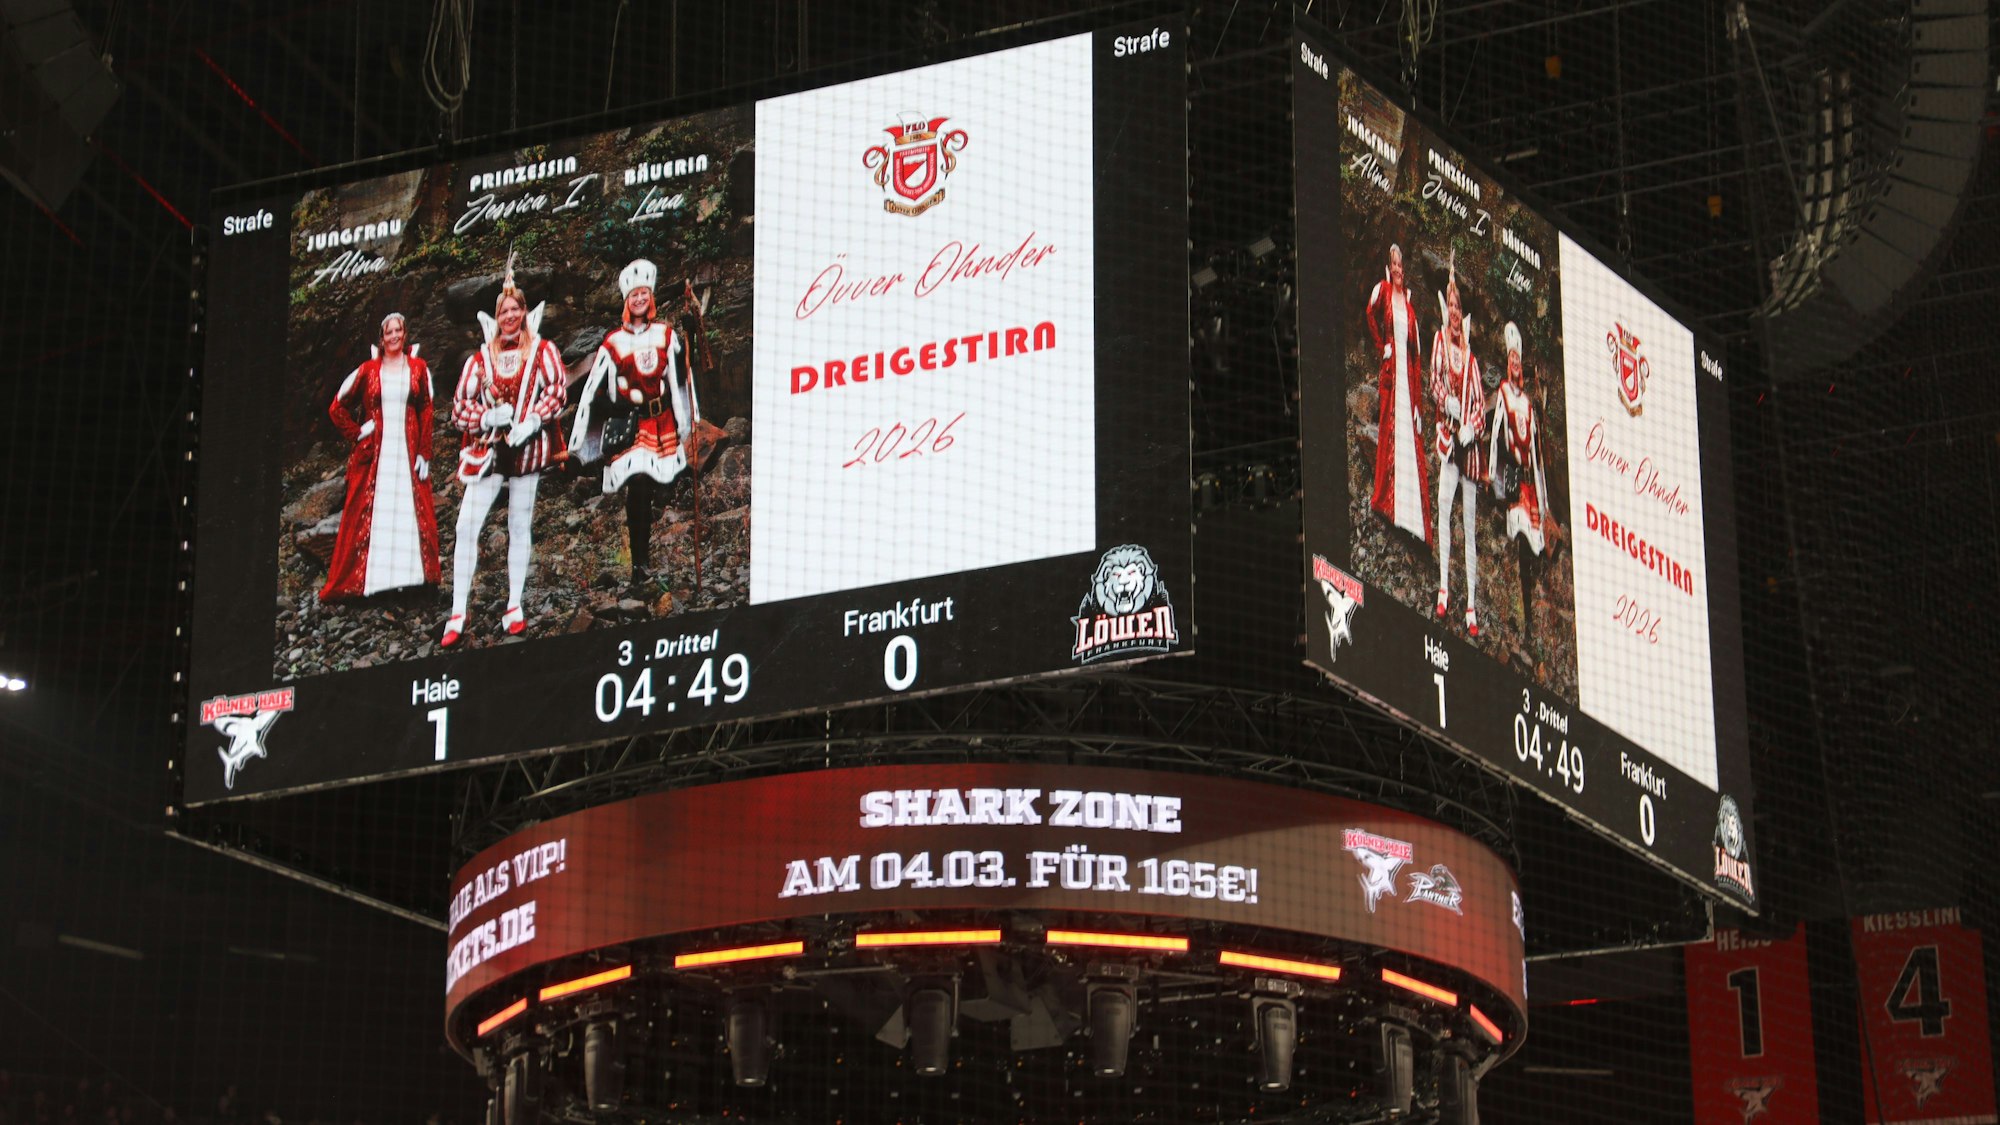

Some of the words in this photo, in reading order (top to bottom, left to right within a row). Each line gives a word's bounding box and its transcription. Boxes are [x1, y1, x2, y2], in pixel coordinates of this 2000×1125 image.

[1113, 27, 1170, 57] Strafe
[1300, 41, 1329, 80] Strafe
[1347, 115, 1396, 165] JUNGFRAU
[470, 156, 577, 192] PRINZESSIN
[624, 153, 708, 187] BÄUERIN
[1350, 153, 1391, 192] Alina
[1428, 148, 1480, 202] PRINZESSIN
[453, 190, 547, 235] Jessica
[626, 185, 684, 223] Lena
[1422, 171, 1468, 220] Jessica
[222, 208, 274, 237] Strafe
[306, 219, 401, 252] JUNGFRAU
[308, 248, 386, 289] Alina
[795, 253, 905, 320] Övver
[914, 231, 1057, 298] Ohnder
[1506, 258, 1532, 293] Lena
[790, 321, 1056, 395] DREIGESTIRN
[1701, 350, 1723, 381] Strafe
[842, 412, 966, 469] 2026
[1585, 416, 1631, 475] Övver
[1634, 456, 1689, 517] Ohnder
[1586, 502, 1694, 597] DREIGESTIRN
[843, 596, 954, 637] Frankfurt
[1076, 605, 1175, 655] LÖWEN
[1612, 593, 1662, 645] 2026
[618, 640, 633, 667] 3
[884, 634, 917, 692] 0
[1424, 634, 1449, 673] Haie
[203, 697, 257, 723] KÖLNER
[258, 689, 292, 711] HAIE
[412, 674, 460, 706] Haie
[595, 653, 751, 723] 04:49
[1434, 673, 1447, 729] 1
[1523, 688, 1531, 714] 3
[427, 707, 448, 761] 1
[1514, 713, 1585, 794] 04:49
[1621, 751, 1668, 800] Frankfurt
[860, 787, 1042, 828] SHARK
[1049, 790, 1182, 833] ZONE
[1639, 794, 1656, 847] 0
[473, 858, 510, 910] ALS
[512, 838, 566, 888] VIP!
[778, 854, 860, 898] AM
[870, 851, 1016, 889] 04.03.
[1025, 844, 1131, 892] FÜR
[1138, 857, 1258, 904] 165€!
[1405, 871, 1463, 913] PANTHER
[1863, 906, 1960, 933] KIESSLIN
[1726, 966, 1764, 1059] 1
[1884, 944, 1952, 1039] 4
